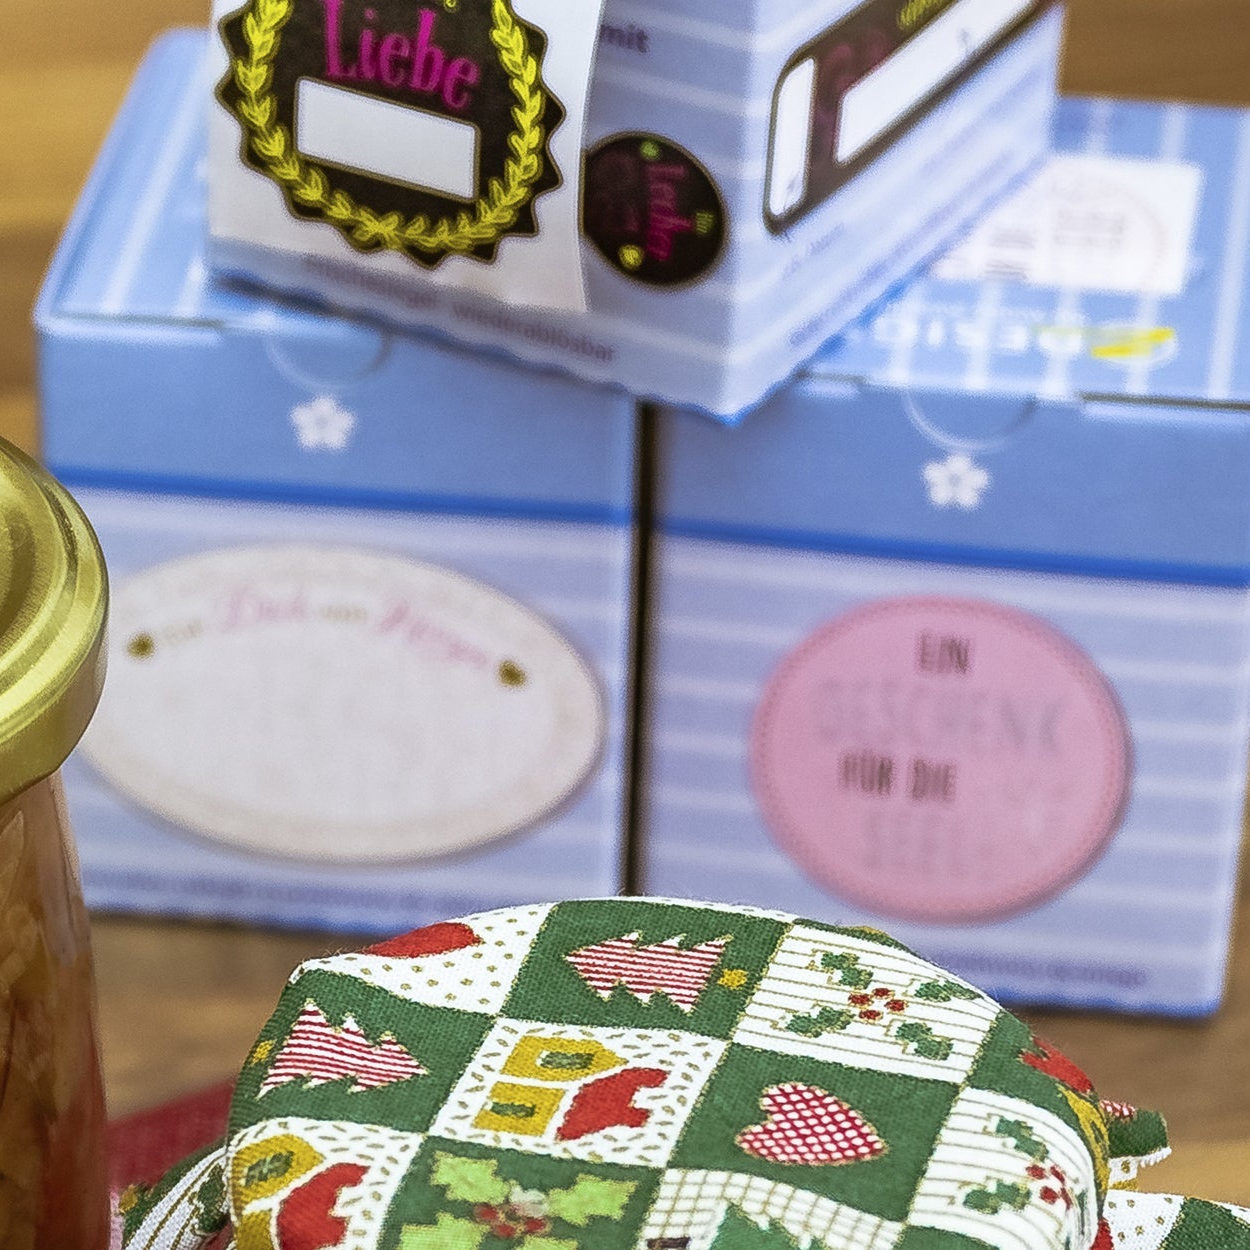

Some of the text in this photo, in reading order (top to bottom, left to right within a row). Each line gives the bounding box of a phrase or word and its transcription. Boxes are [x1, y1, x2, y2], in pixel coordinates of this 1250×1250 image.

[323, 0, 481, 111] Liebe
[917, 629, 972, 675] EIN
[908, 756, 956, 803] DIE
